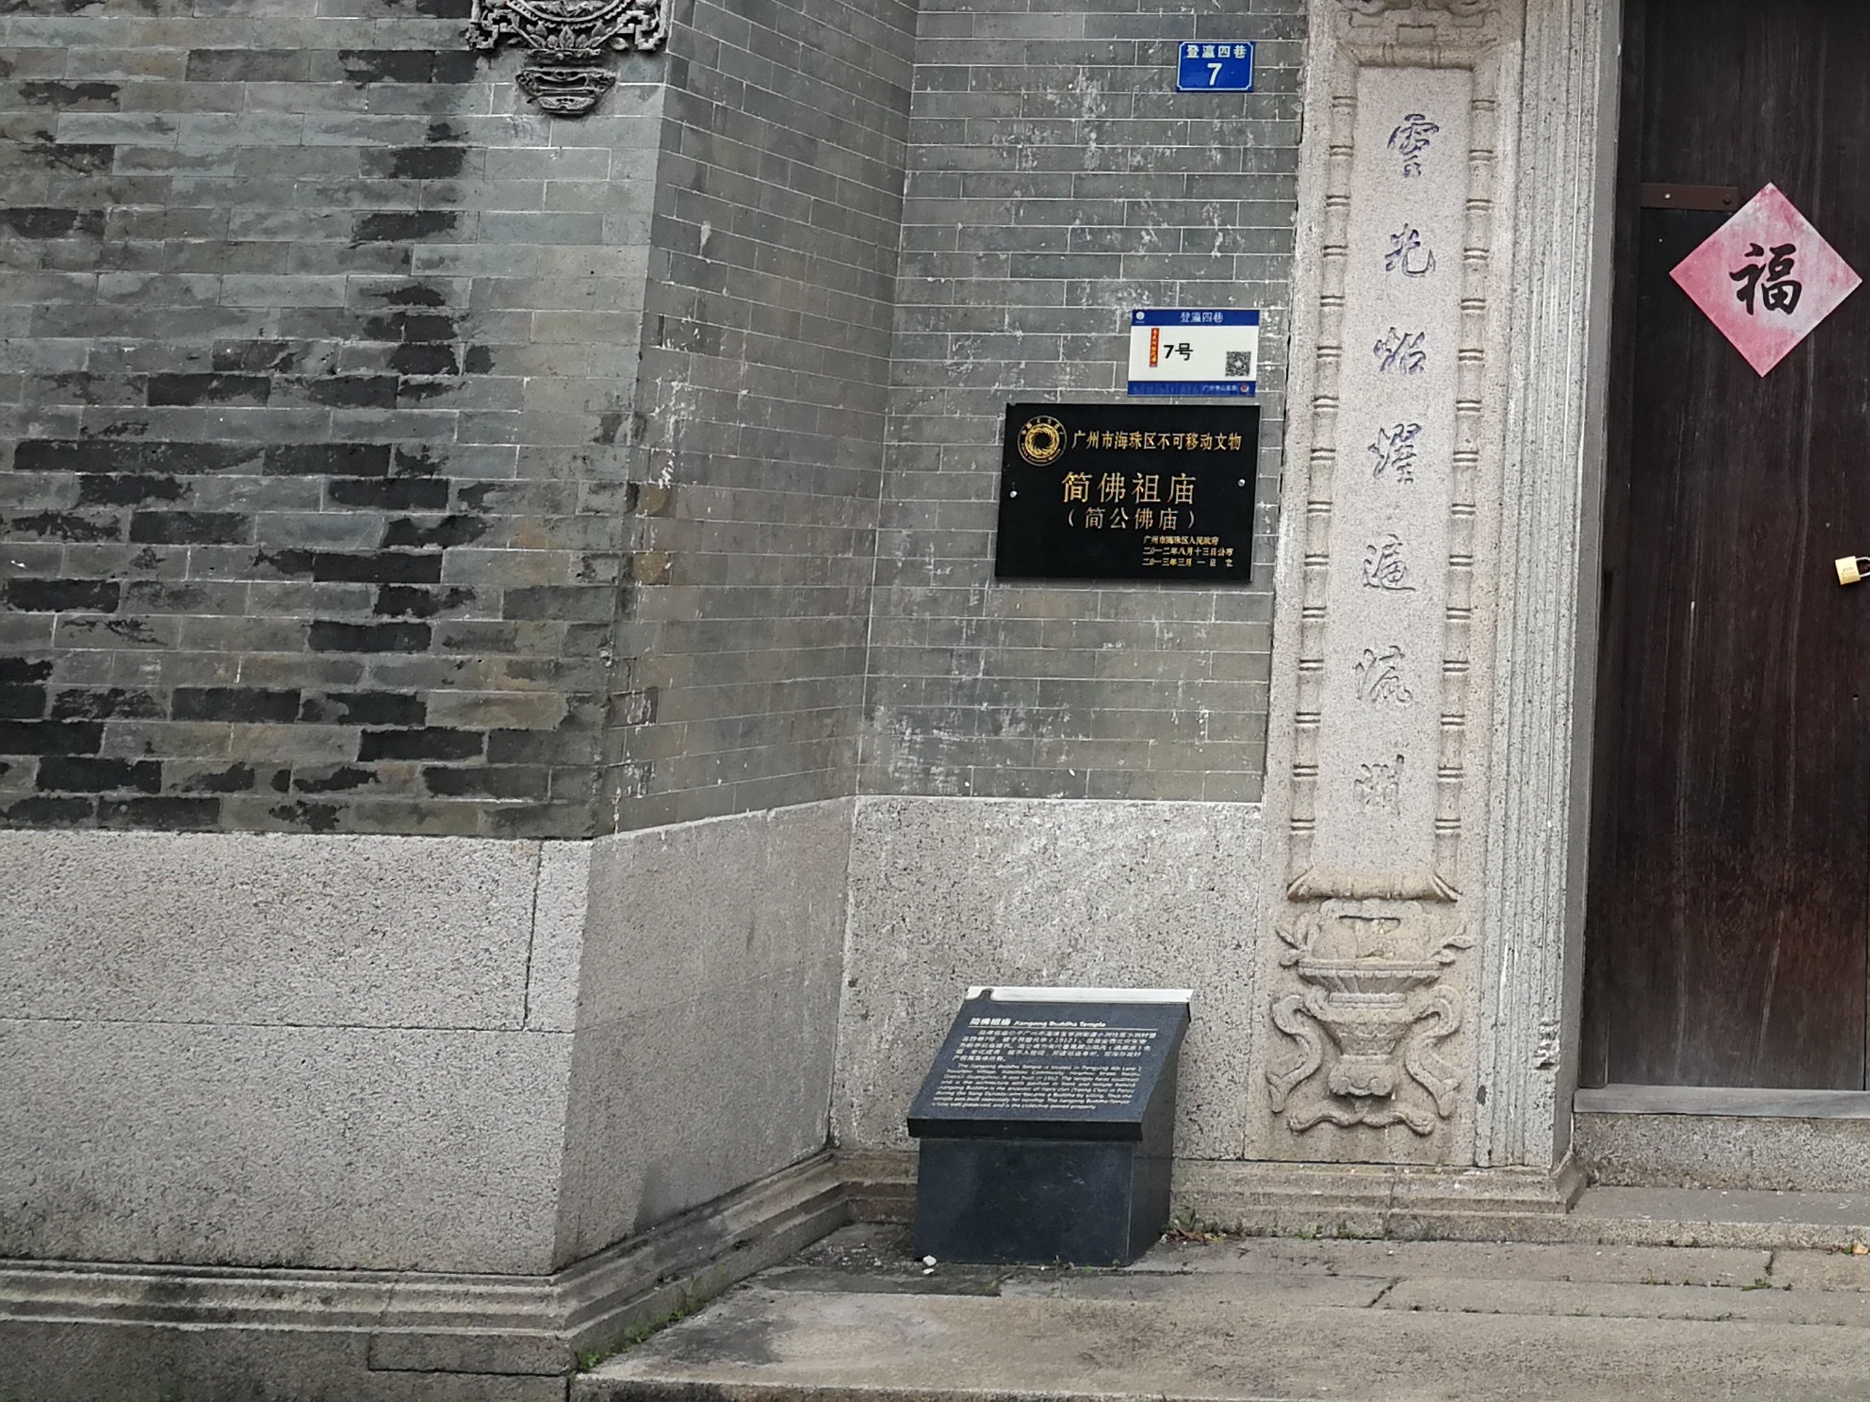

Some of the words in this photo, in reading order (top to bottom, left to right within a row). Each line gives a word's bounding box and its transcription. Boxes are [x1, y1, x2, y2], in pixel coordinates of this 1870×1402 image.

[1186, 44, 1247, 60] 登瀛四巷
[1206, 63, 1222, 86] 7
[1728, 241, 1804, 317] 福
[1163, 342, 1194, 361] 7号
[1070, 429, 1242, 451] 广州市海珠区不可移动文物
[1061, 471, 1197, 505] 简佛祖庙
